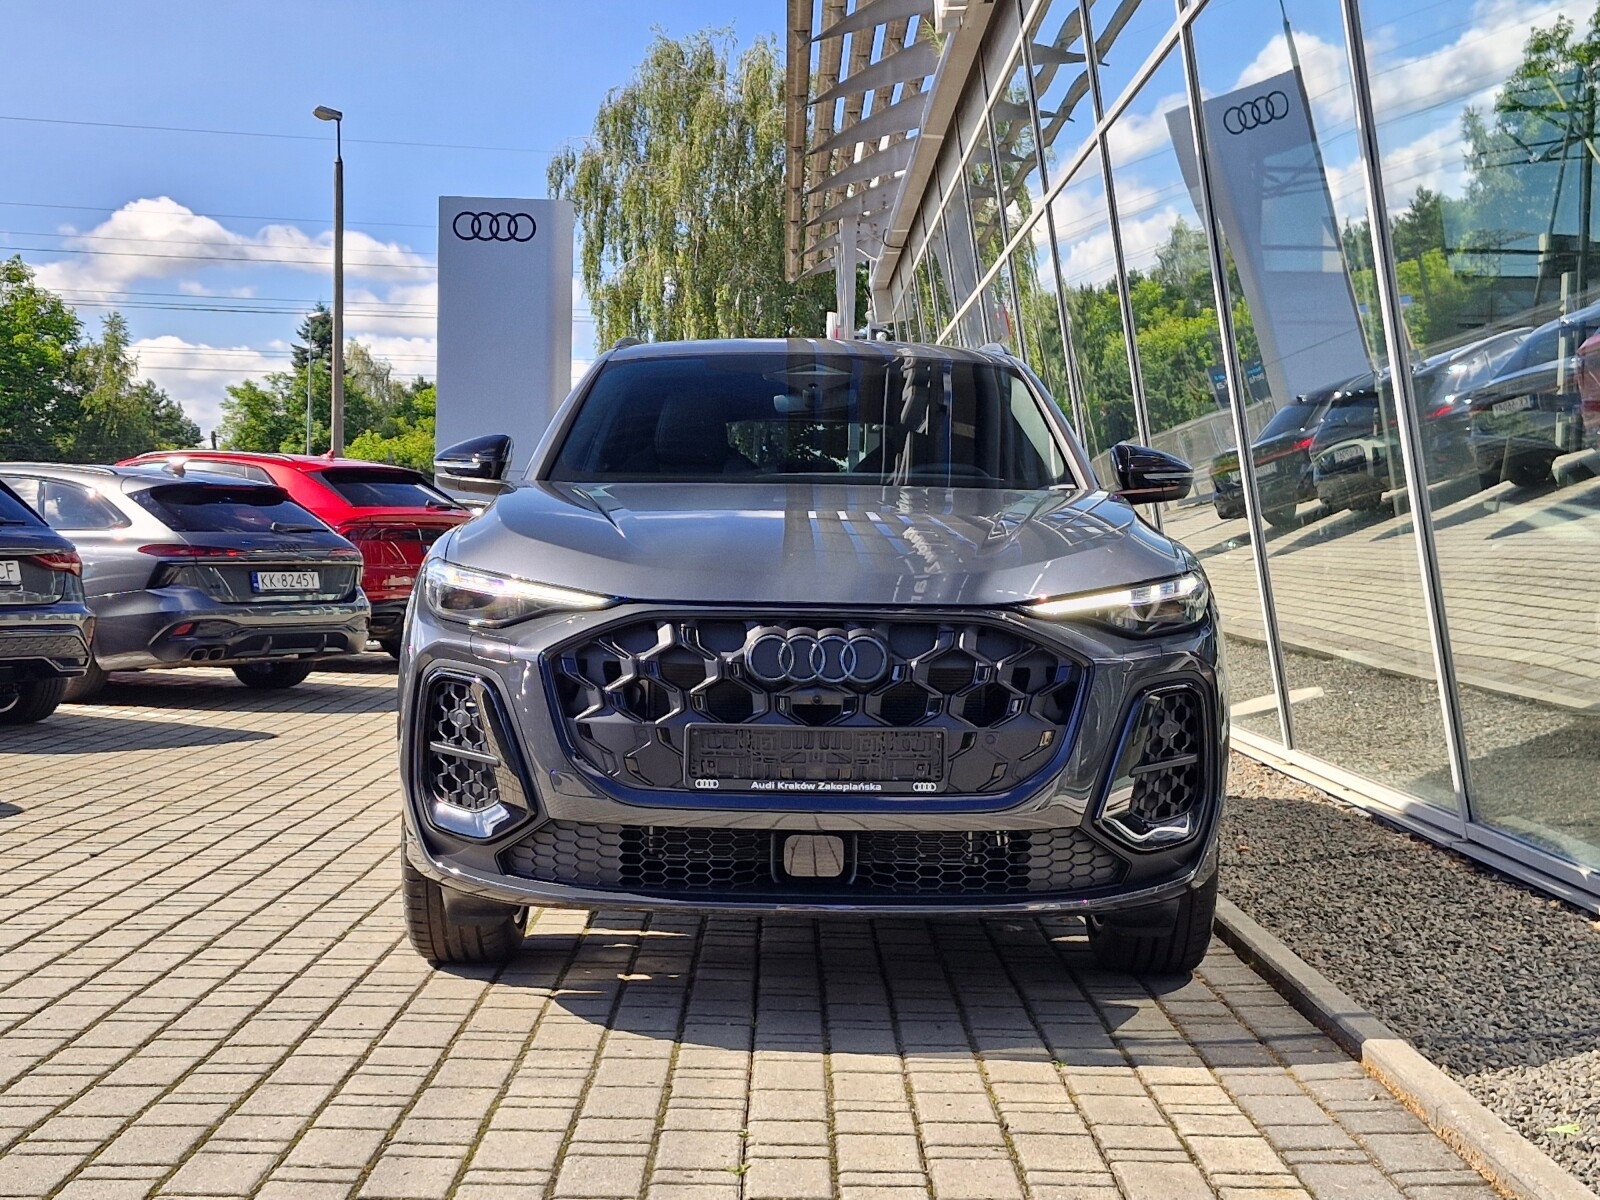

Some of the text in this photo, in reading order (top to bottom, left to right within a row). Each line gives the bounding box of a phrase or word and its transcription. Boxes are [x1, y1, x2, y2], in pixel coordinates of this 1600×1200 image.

[260, 573, 316, 588] KK 8245Y
[750, 781, 882, 792] Audi Kraków Zakopiańska
